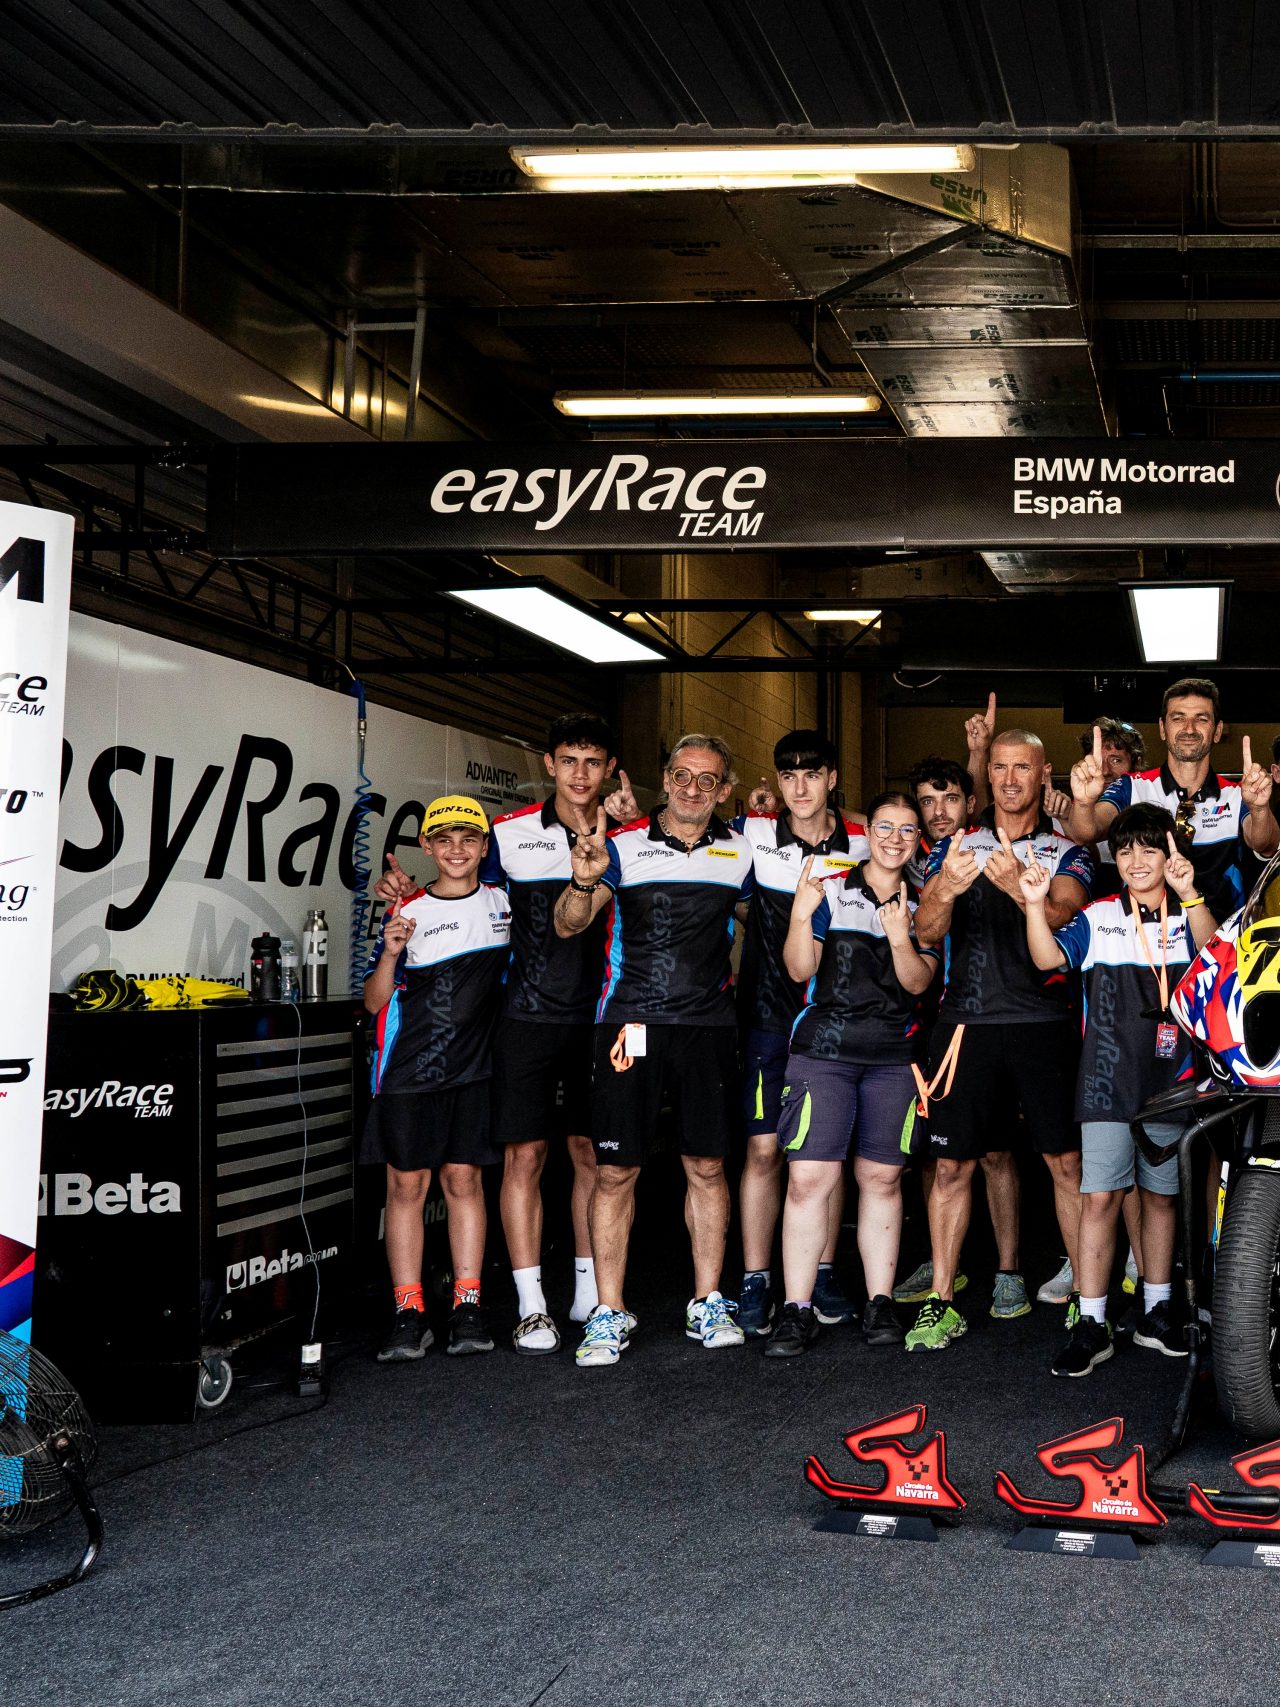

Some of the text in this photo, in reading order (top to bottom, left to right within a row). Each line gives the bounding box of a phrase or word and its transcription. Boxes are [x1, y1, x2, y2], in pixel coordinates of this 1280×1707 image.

[1013, 457, 1236, 483] BMW Motorrad
[430, 454, 767, 530] easyRace
[1013, 488, 1122, 519] España
[678, 512, 764, 537] TEAM
[465, 760, 518, 791] ADVANTEC
[428, 805, 481, 819] DUNLOP
[43, 1080, 174, 1118] asyRace
[134, 1104, 173, 1118] TEAM
[54, 1173, 181, 1217] Beta
[896, 1486, 939, 1500] Navarra
[1092, 1501, 1139, 1517] Navarra
